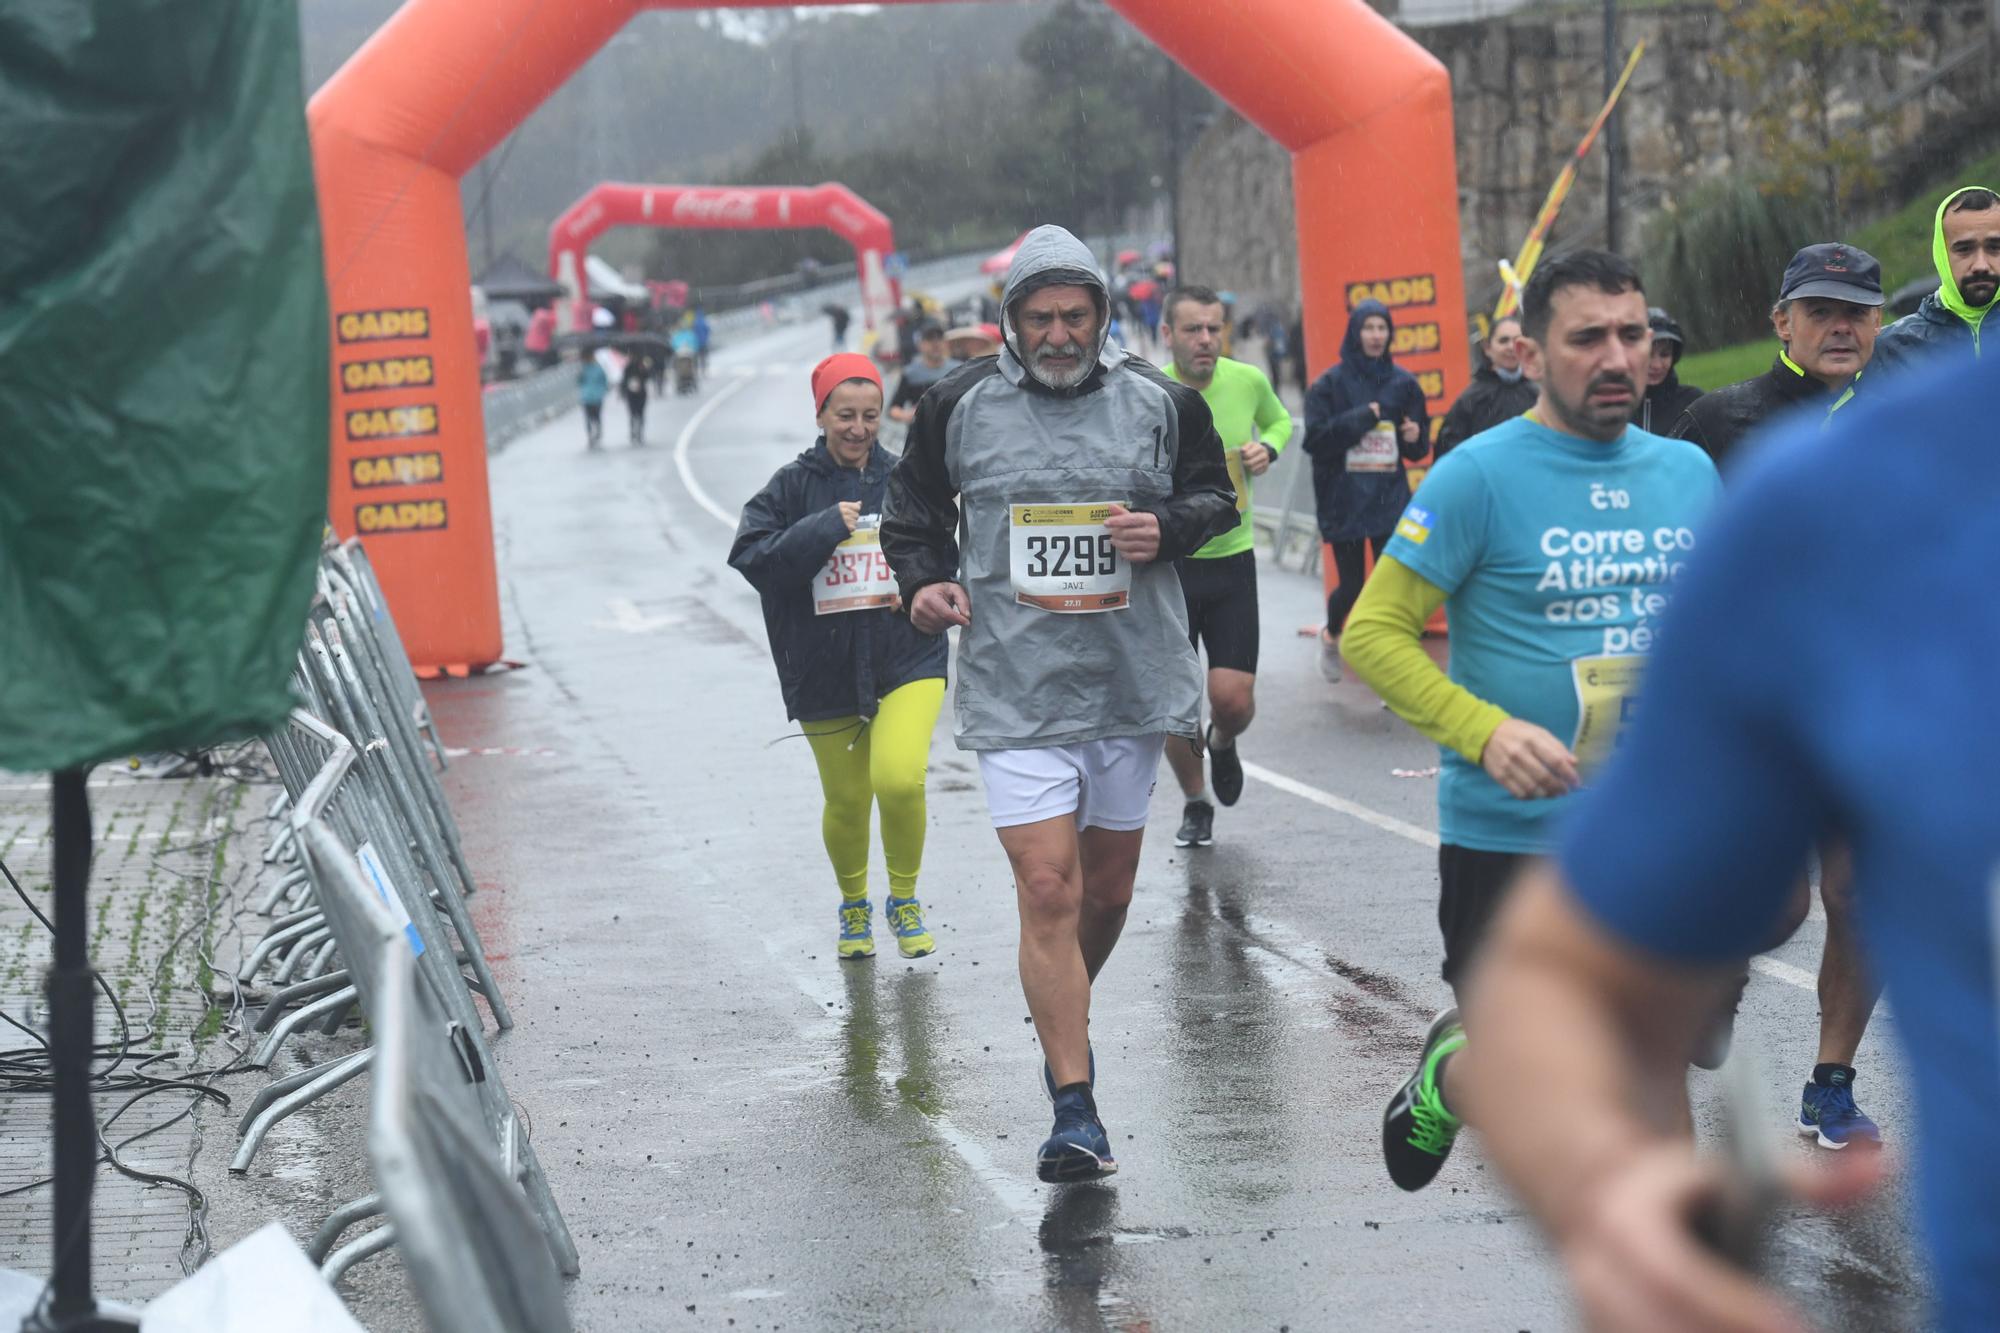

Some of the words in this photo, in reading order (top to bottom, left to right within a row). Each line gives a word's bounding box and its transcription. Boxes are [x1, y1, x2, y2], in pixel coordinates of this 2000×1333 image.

[340, 310, 428, 340] GADIS
[1389, 321, 1439, 353] DIS
[344, 357, 433, 389] GADIS
[349, 405, 437, 437] GADIS
[353, 454, 441, 484] GADIS
[358, 501, 445, 531] GADIS
[1027, 534, 1117, 577] 3299
[1540, 527, 1646, 557] Corre
[825, 552, 890, 586] 3375
[1536, 553, 1687, 592] Atlántic
[1063, 582, 1085, 590] JAVI
[1545, 595, 1621, 623] aos
[1631, 587, 1673, 617] te
[1603, 617, 1664, 656] pé
